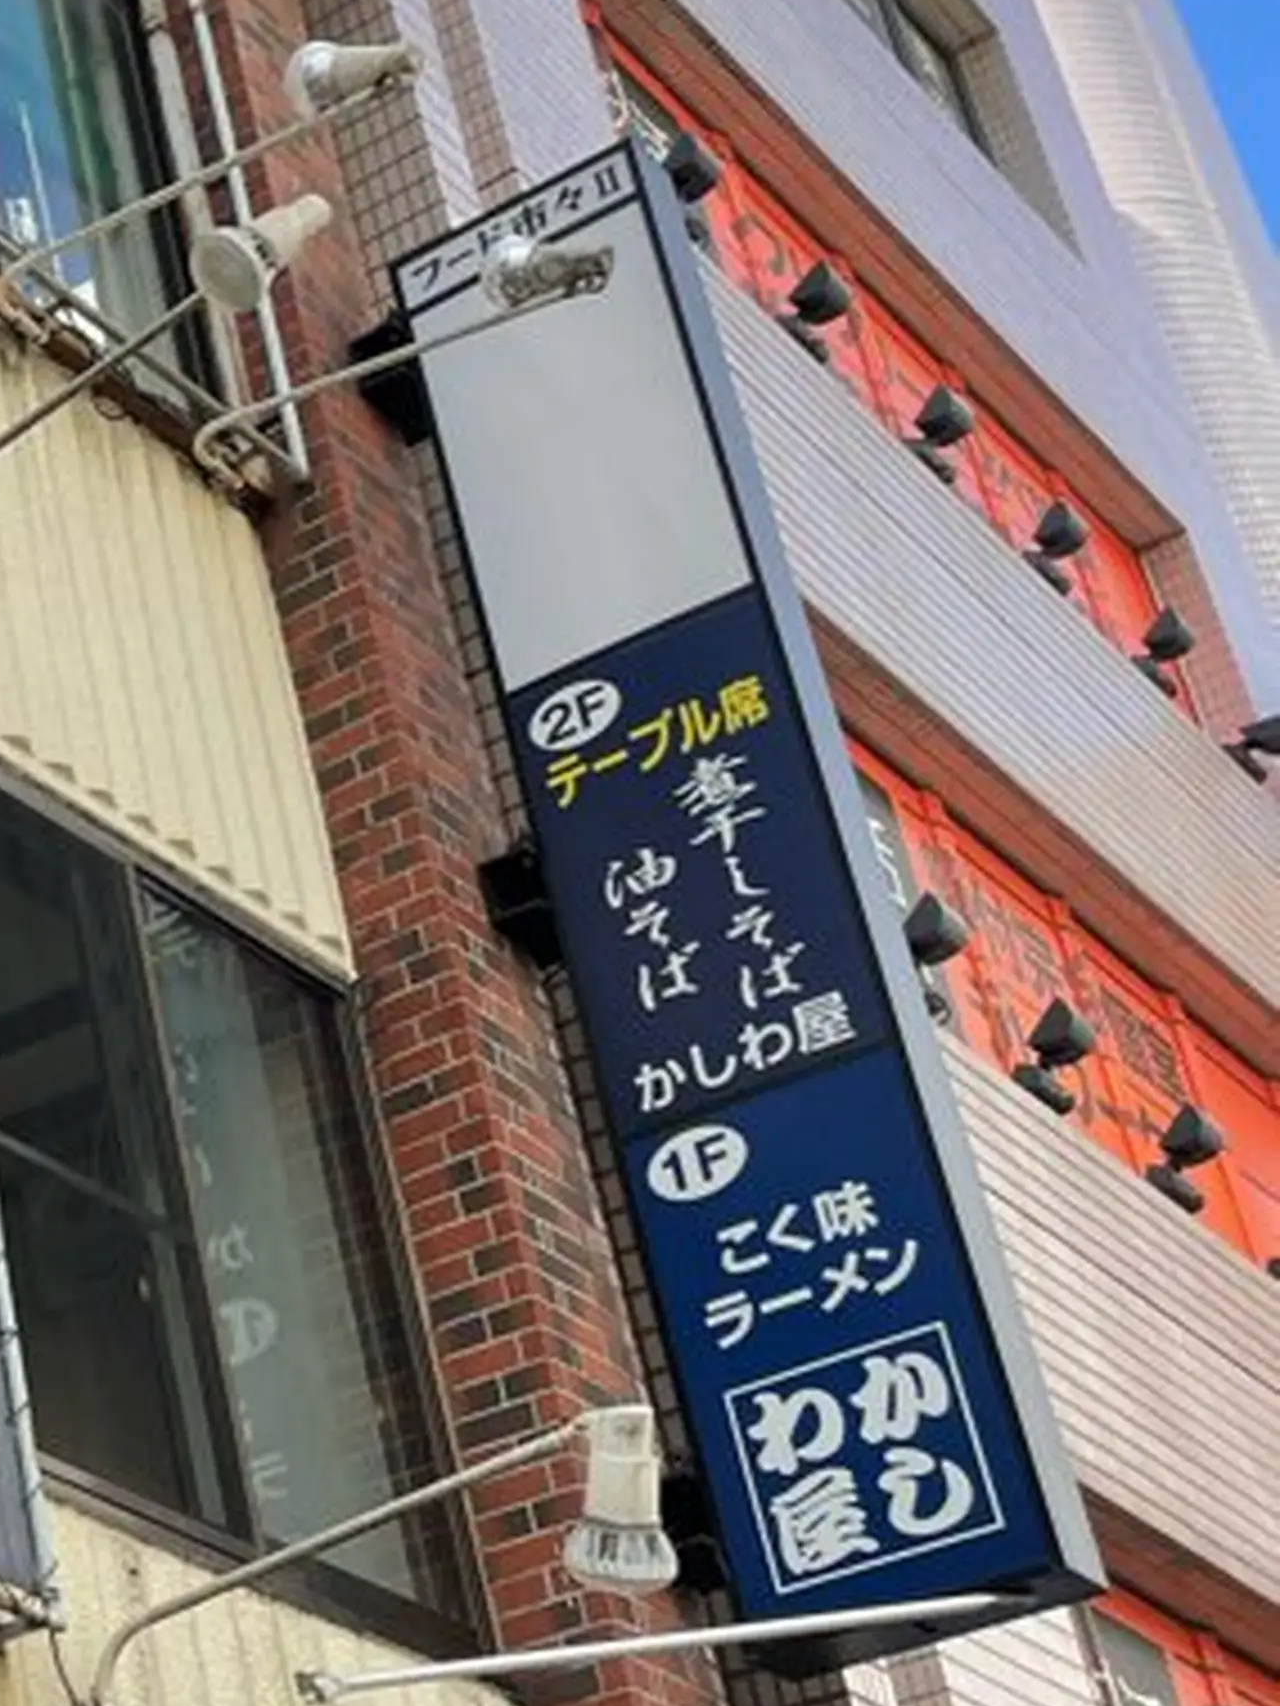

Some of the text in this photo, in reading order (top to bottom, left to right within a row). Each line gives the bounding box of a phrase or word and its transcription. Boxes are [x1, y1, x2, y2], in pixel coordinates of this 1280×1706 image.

[539, 684, 608, 745] 2F
[546, 676, 772, 808] テーブル席
[603, 848, 701, 1013] 油そば
[673, 752, 806, 1009] 煮干しそば
[634, 990, 857, 1113] かしわ屋
[660, 1135, 730, 1195] 1F
[716, 1180, 879, 1275] こく味
[703, 1238, 919, 1350] ラーメン
